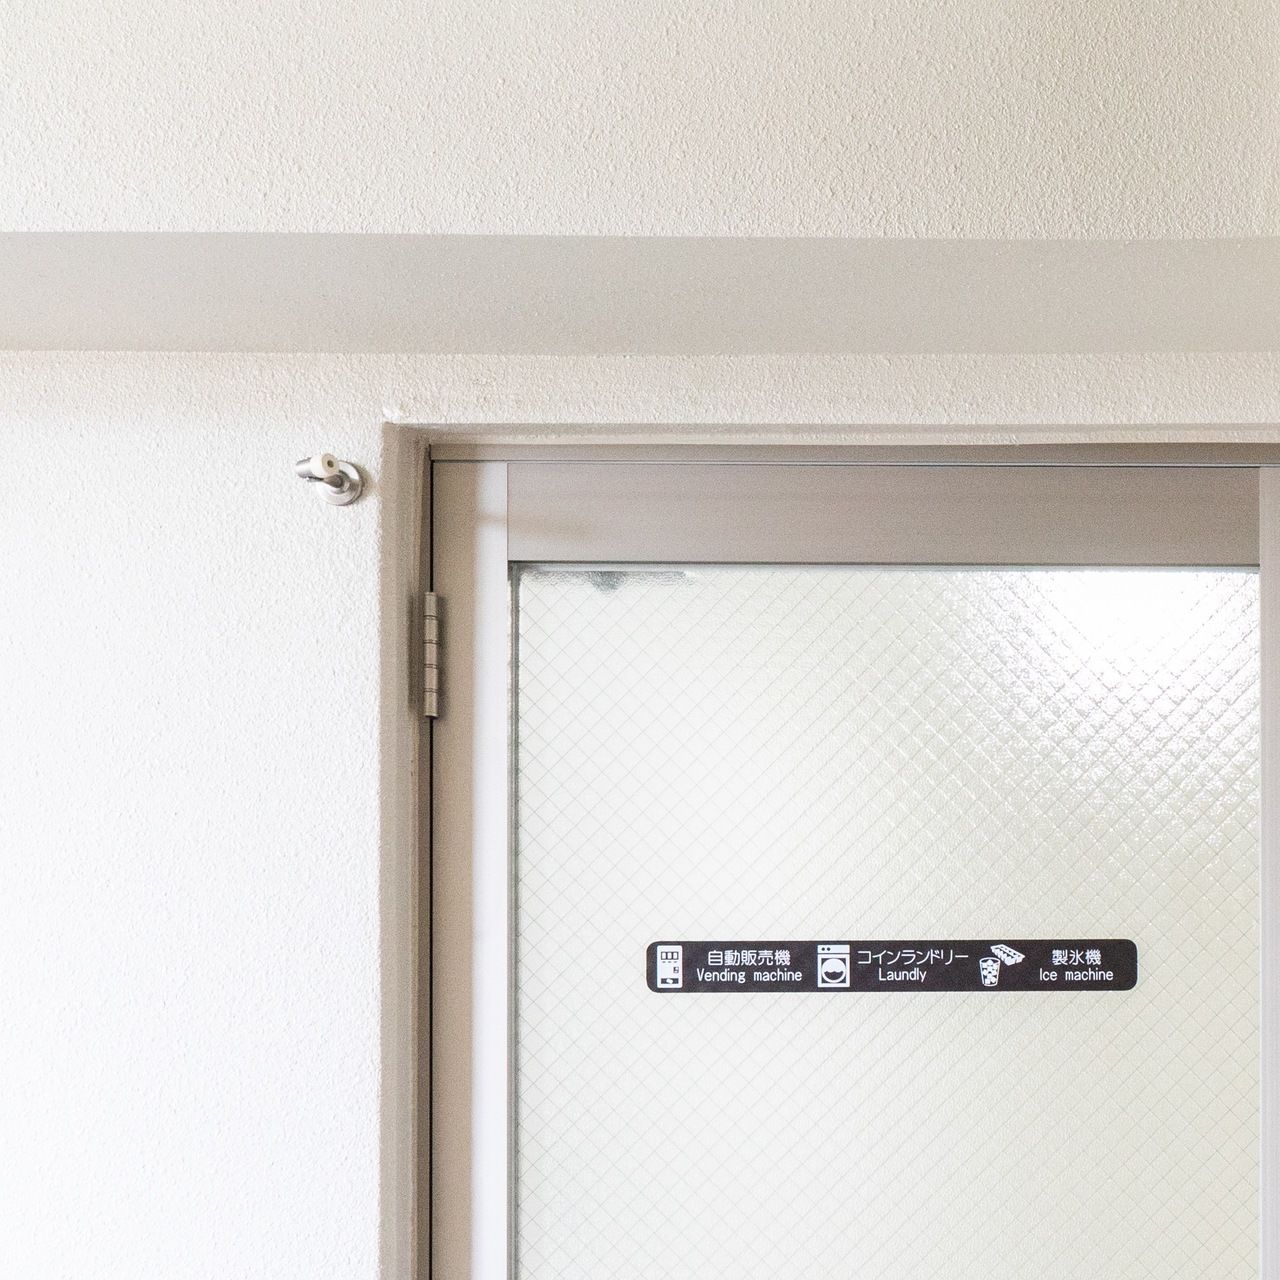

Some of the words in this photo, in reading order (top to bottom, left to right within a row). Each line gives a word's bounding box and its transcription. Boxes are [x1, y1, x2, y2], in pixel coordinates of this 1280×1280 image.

[707, 949, 791, 966] 自動販売機
[857, 949, 969, 966] コインランドリー
[1051, 948, 1102, 965] 製氷機
[697, 967, 748, 984] Vending
[753, 968, 802, 982] machine
[878, 967, 927, 984] Laundly
[1039, 968, 1057, 981] Ice
[1064, 967, 1114, 981] machine
